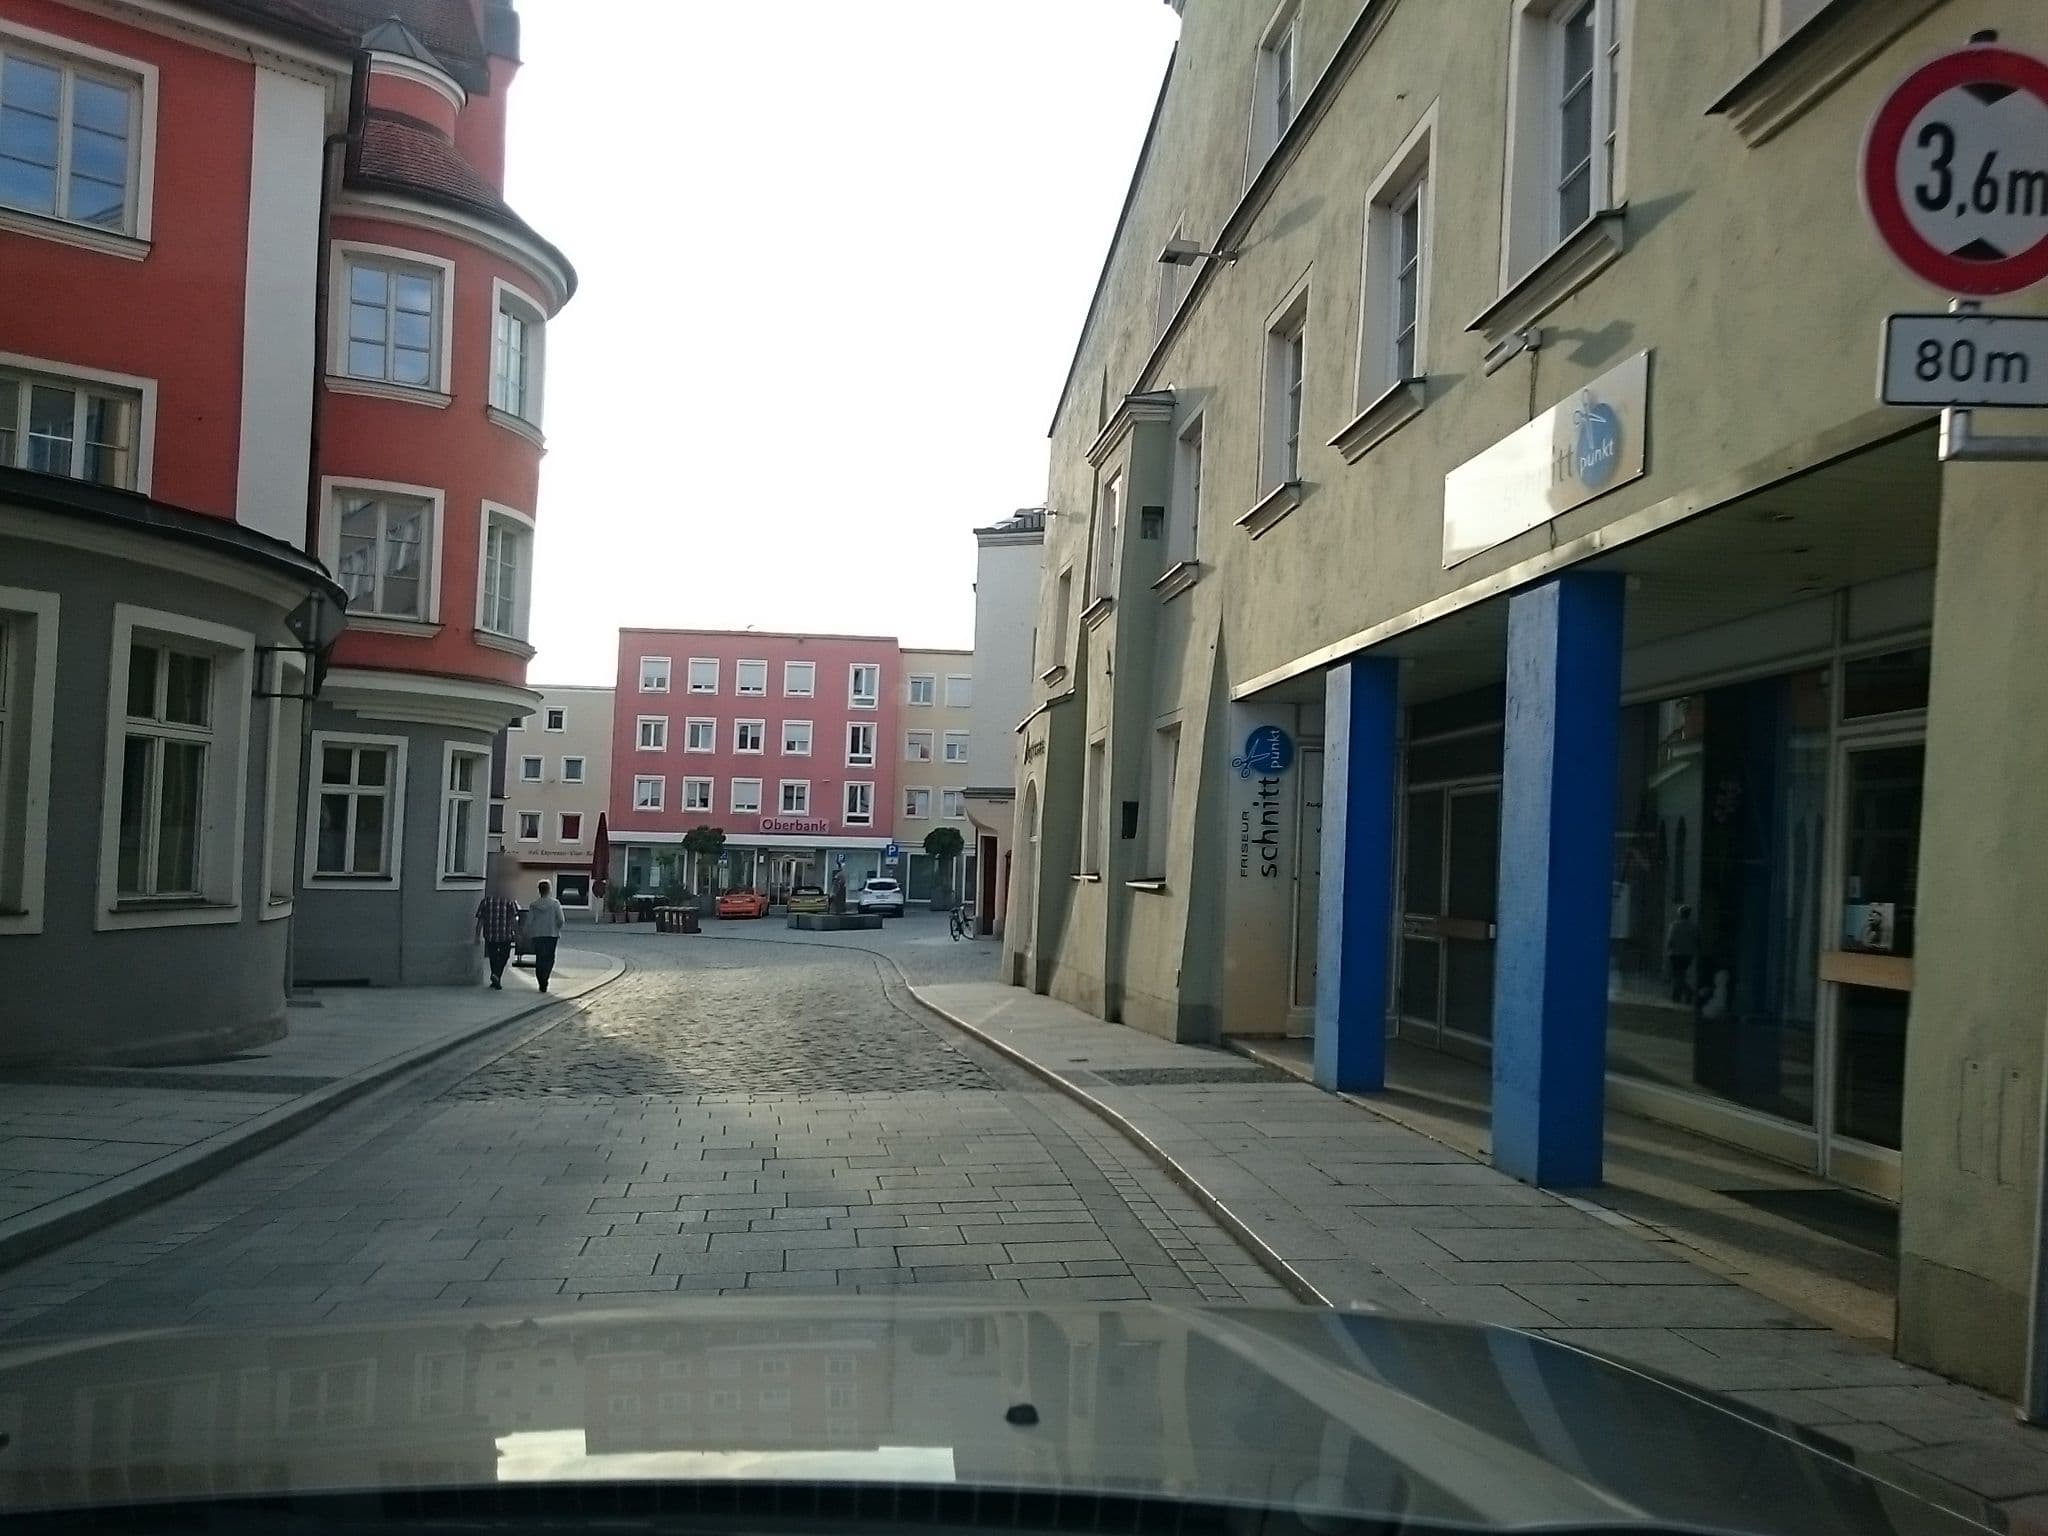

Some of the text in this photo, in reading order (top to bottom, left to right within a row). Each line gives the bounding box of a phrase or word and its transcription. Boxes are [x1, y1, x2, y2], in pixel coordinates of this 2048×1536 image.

[1579, 437, 1615, 478] punkt
[762, 818, 827, 832] Oberbank
[1251, 728, 1284, 879] schnitt punkt
[1240, 810, 1250, 878] FRISEUR
